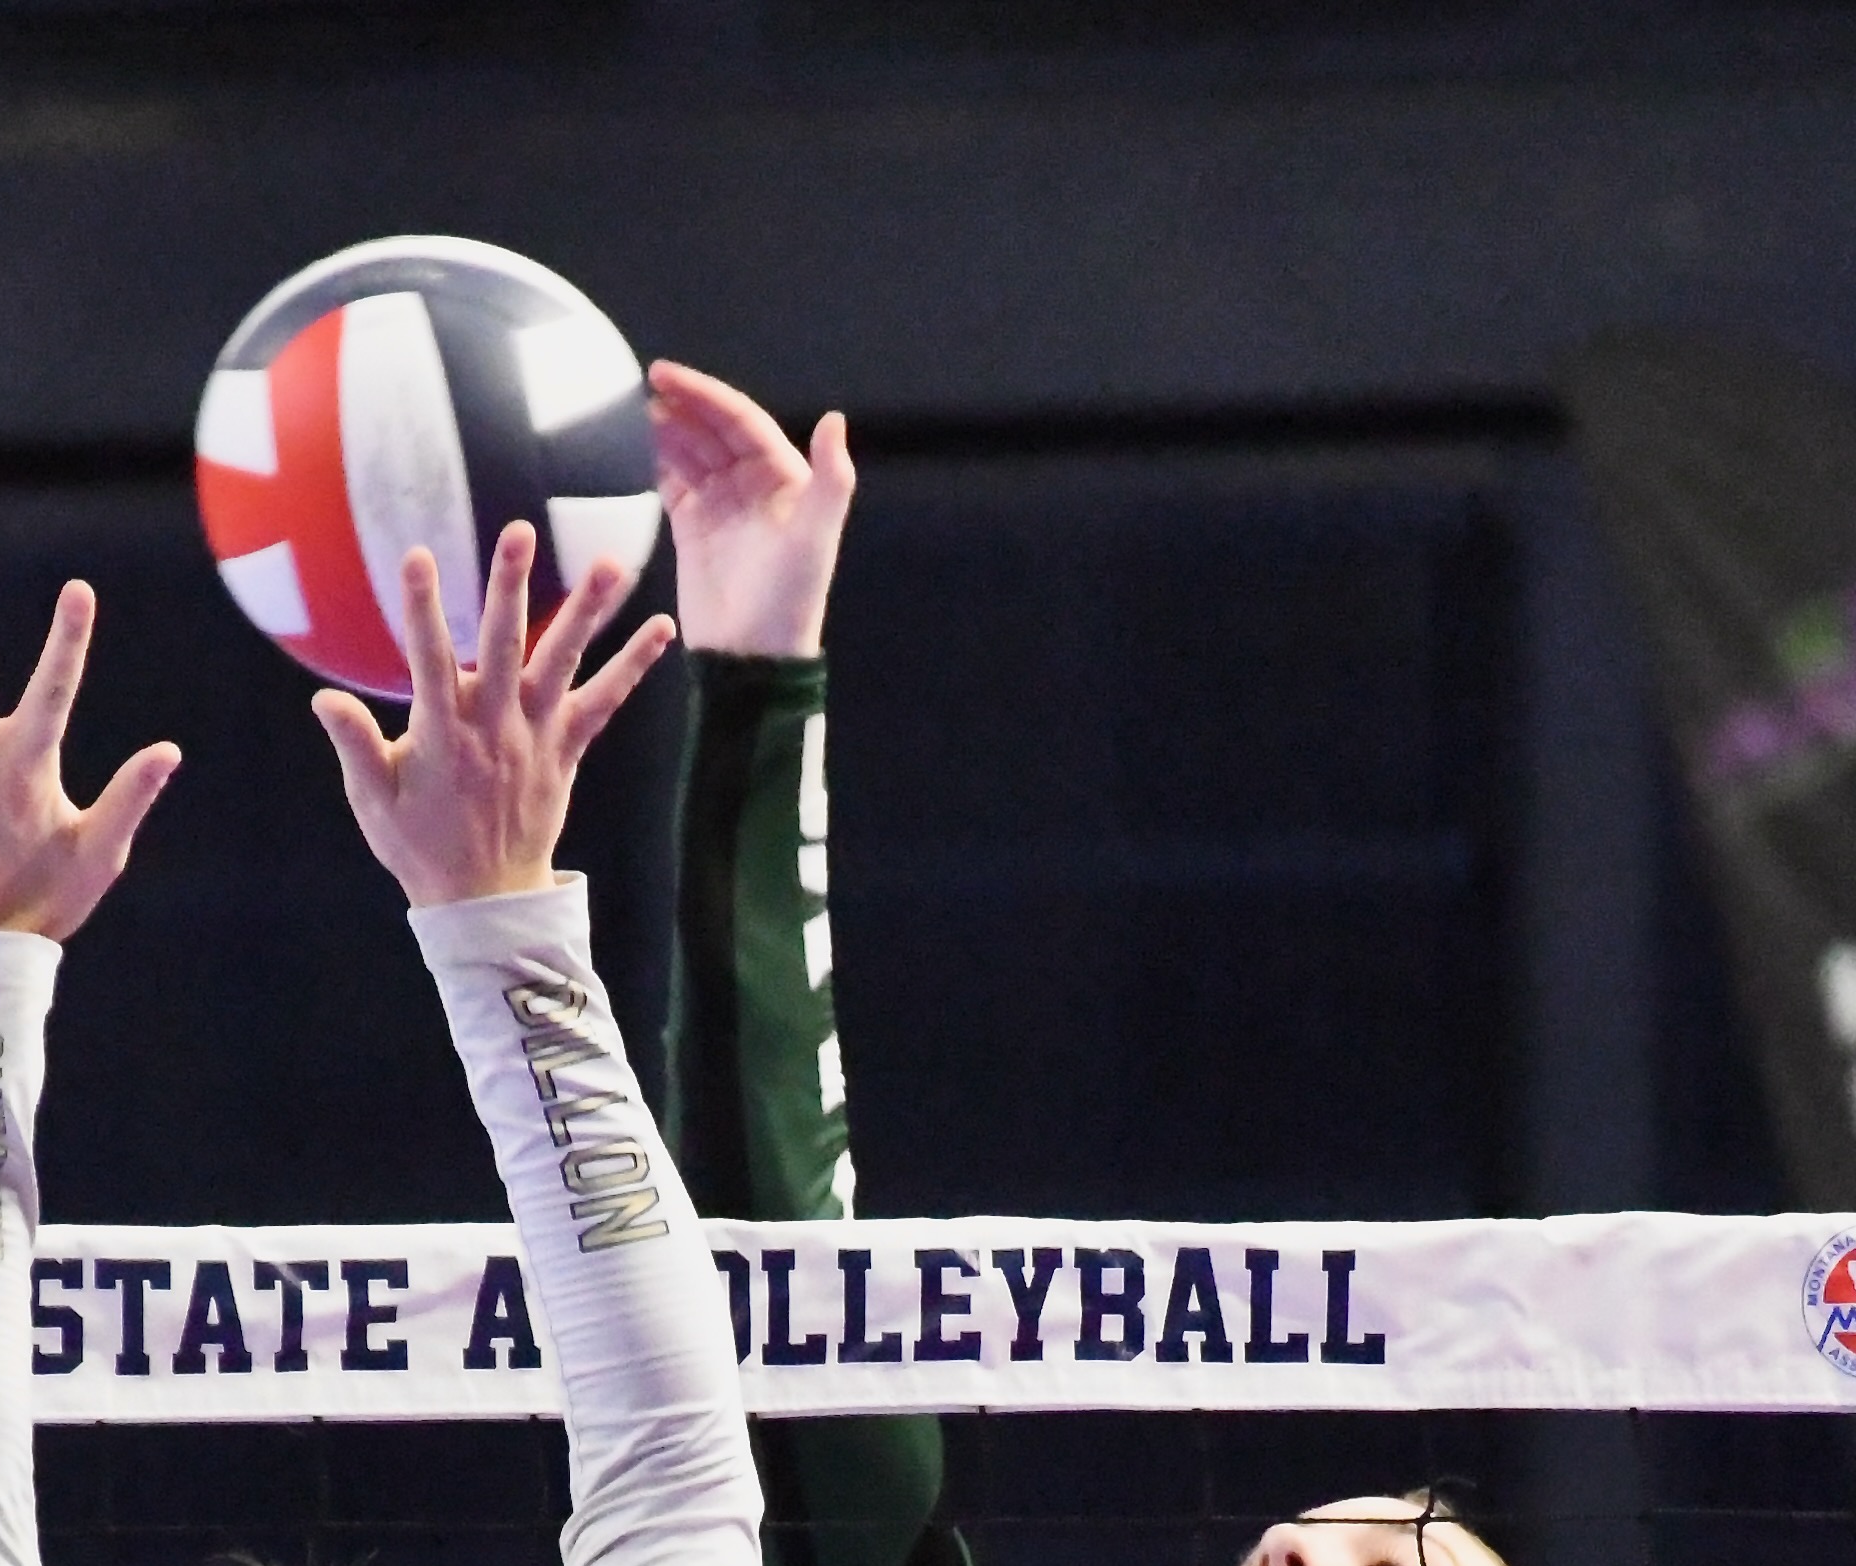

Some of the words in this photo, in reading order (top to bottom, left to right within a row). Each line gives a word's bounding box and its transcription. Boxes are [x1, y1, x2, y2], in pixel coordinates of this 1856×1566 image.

[503, 978, 670, 1254] DILLON
[30, 1257, 409, 1376] STATE
[462, 1256, 542, 1370] A
[712, 1247, 1386, 1366] LLEYBALL
